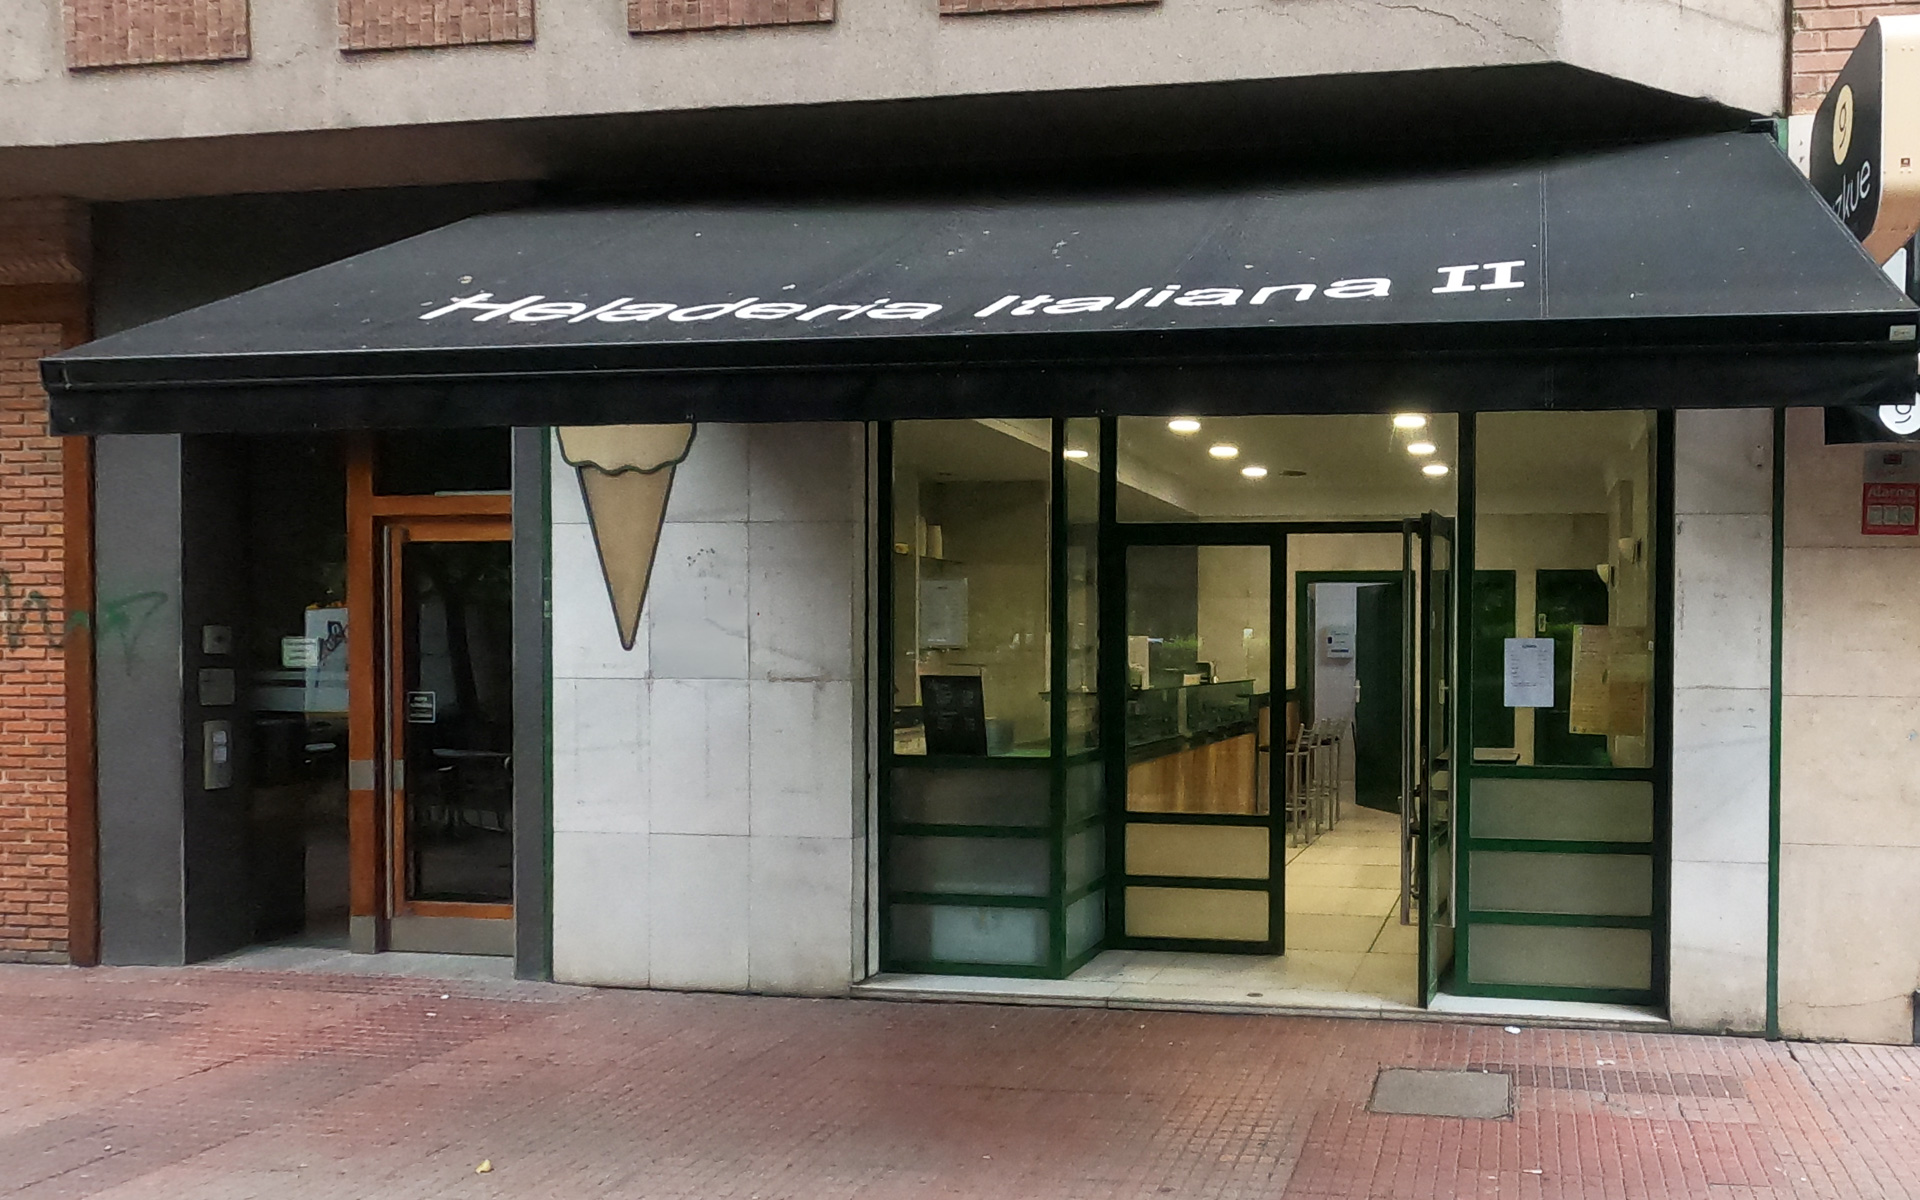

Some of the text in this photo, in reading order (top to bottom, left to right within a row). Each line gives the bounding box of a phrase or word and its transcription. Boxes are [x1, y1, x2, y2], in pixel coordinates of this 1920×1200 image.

[418, 260, 1526, 323] Heladeria Italiana II
